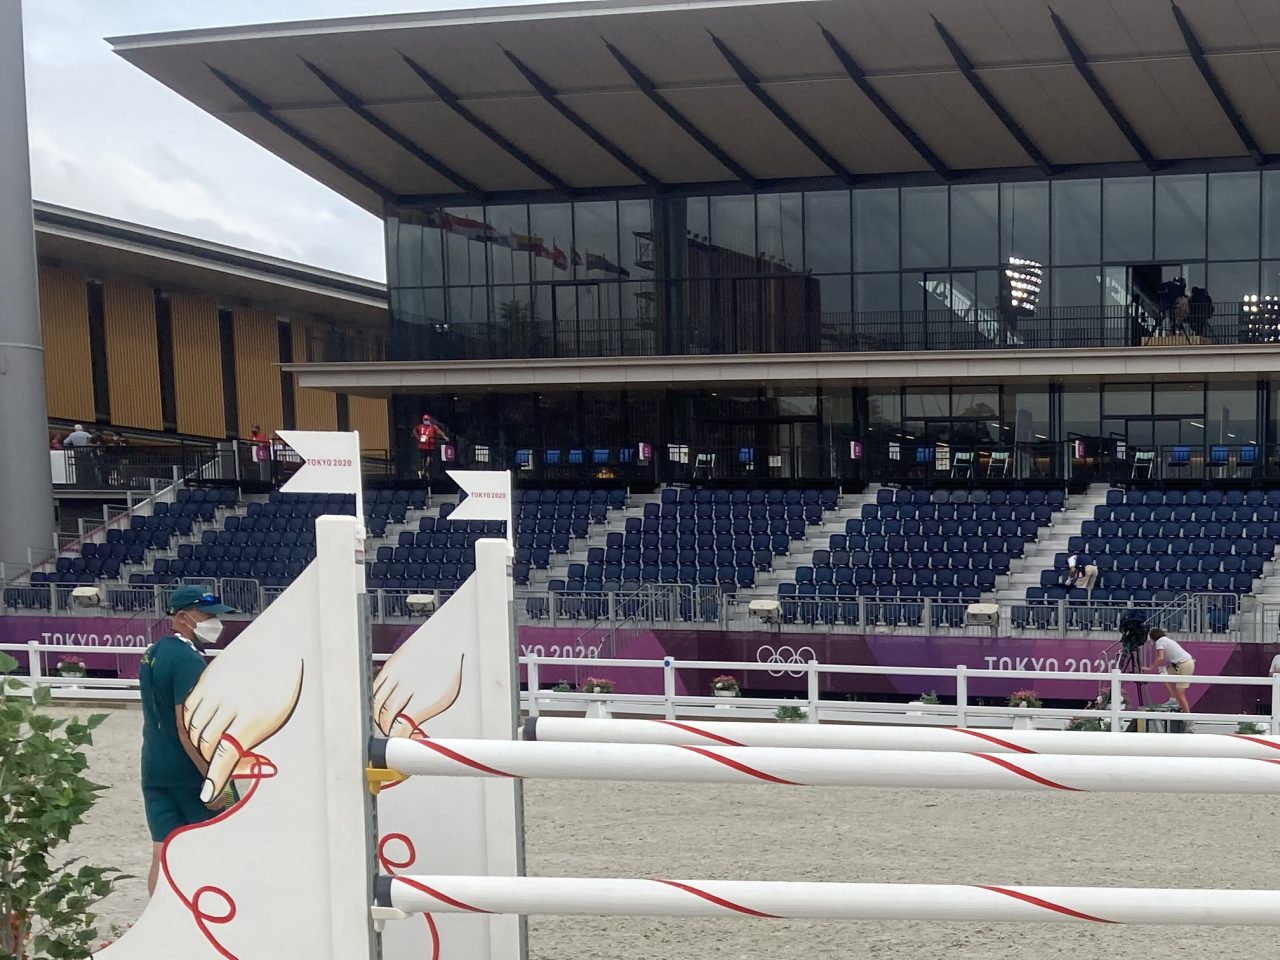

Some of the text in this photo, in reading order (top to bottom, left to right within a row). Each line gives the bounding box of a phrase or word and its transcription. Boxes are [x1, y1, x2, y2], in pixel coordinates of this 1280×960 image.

[307, 458, 352, 467] TOKYO 2020
[41, 632, 145, 647] TOKYO 2020
[984, 656, 1058, 672] TOKYO
